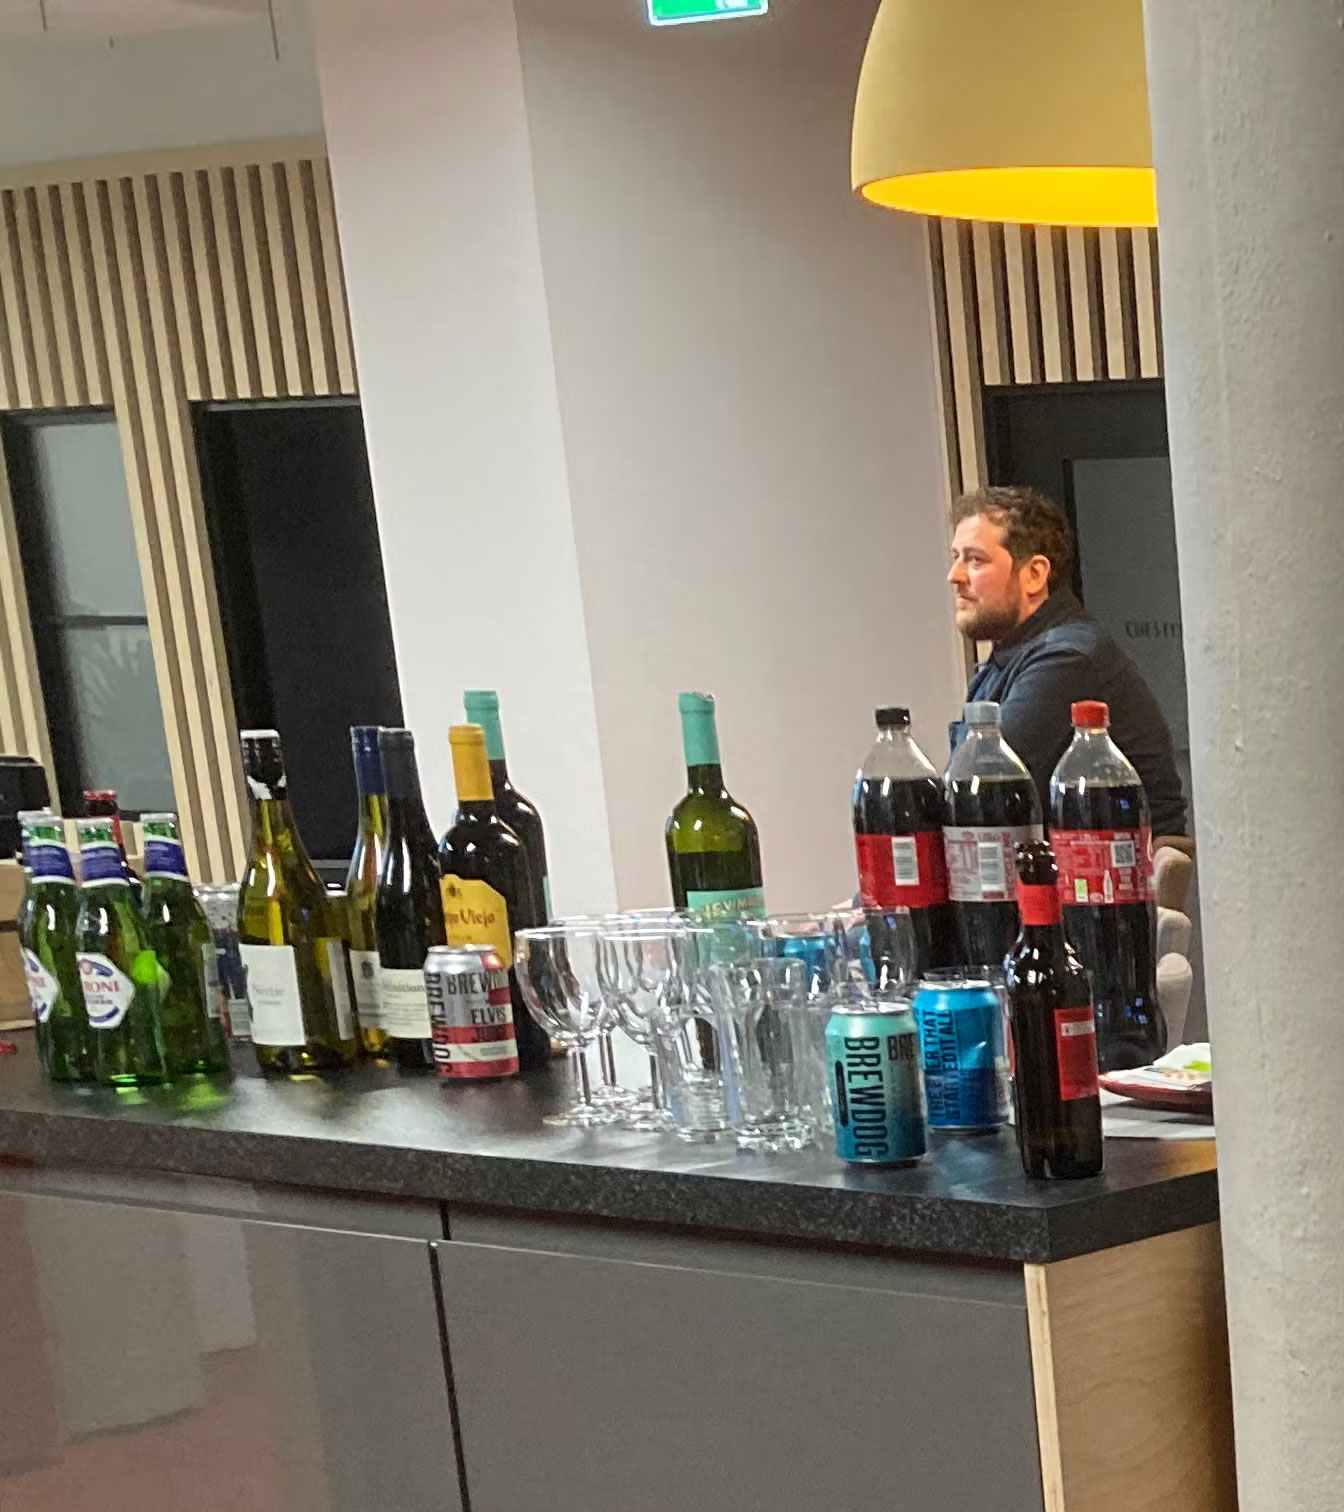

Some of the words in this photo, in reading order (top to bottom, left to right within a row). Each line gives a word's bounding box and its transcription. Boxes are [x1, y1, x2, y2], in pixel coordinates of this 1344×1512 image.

[459, 909, 496, 927] Viejo
[83, 980, 120, 993] RONI
[470, 1006, 507, 1025] ELVIS
[922, 1009, 939, 1048] THAT
[843, 1036, 889, 1156] BREWDOG
